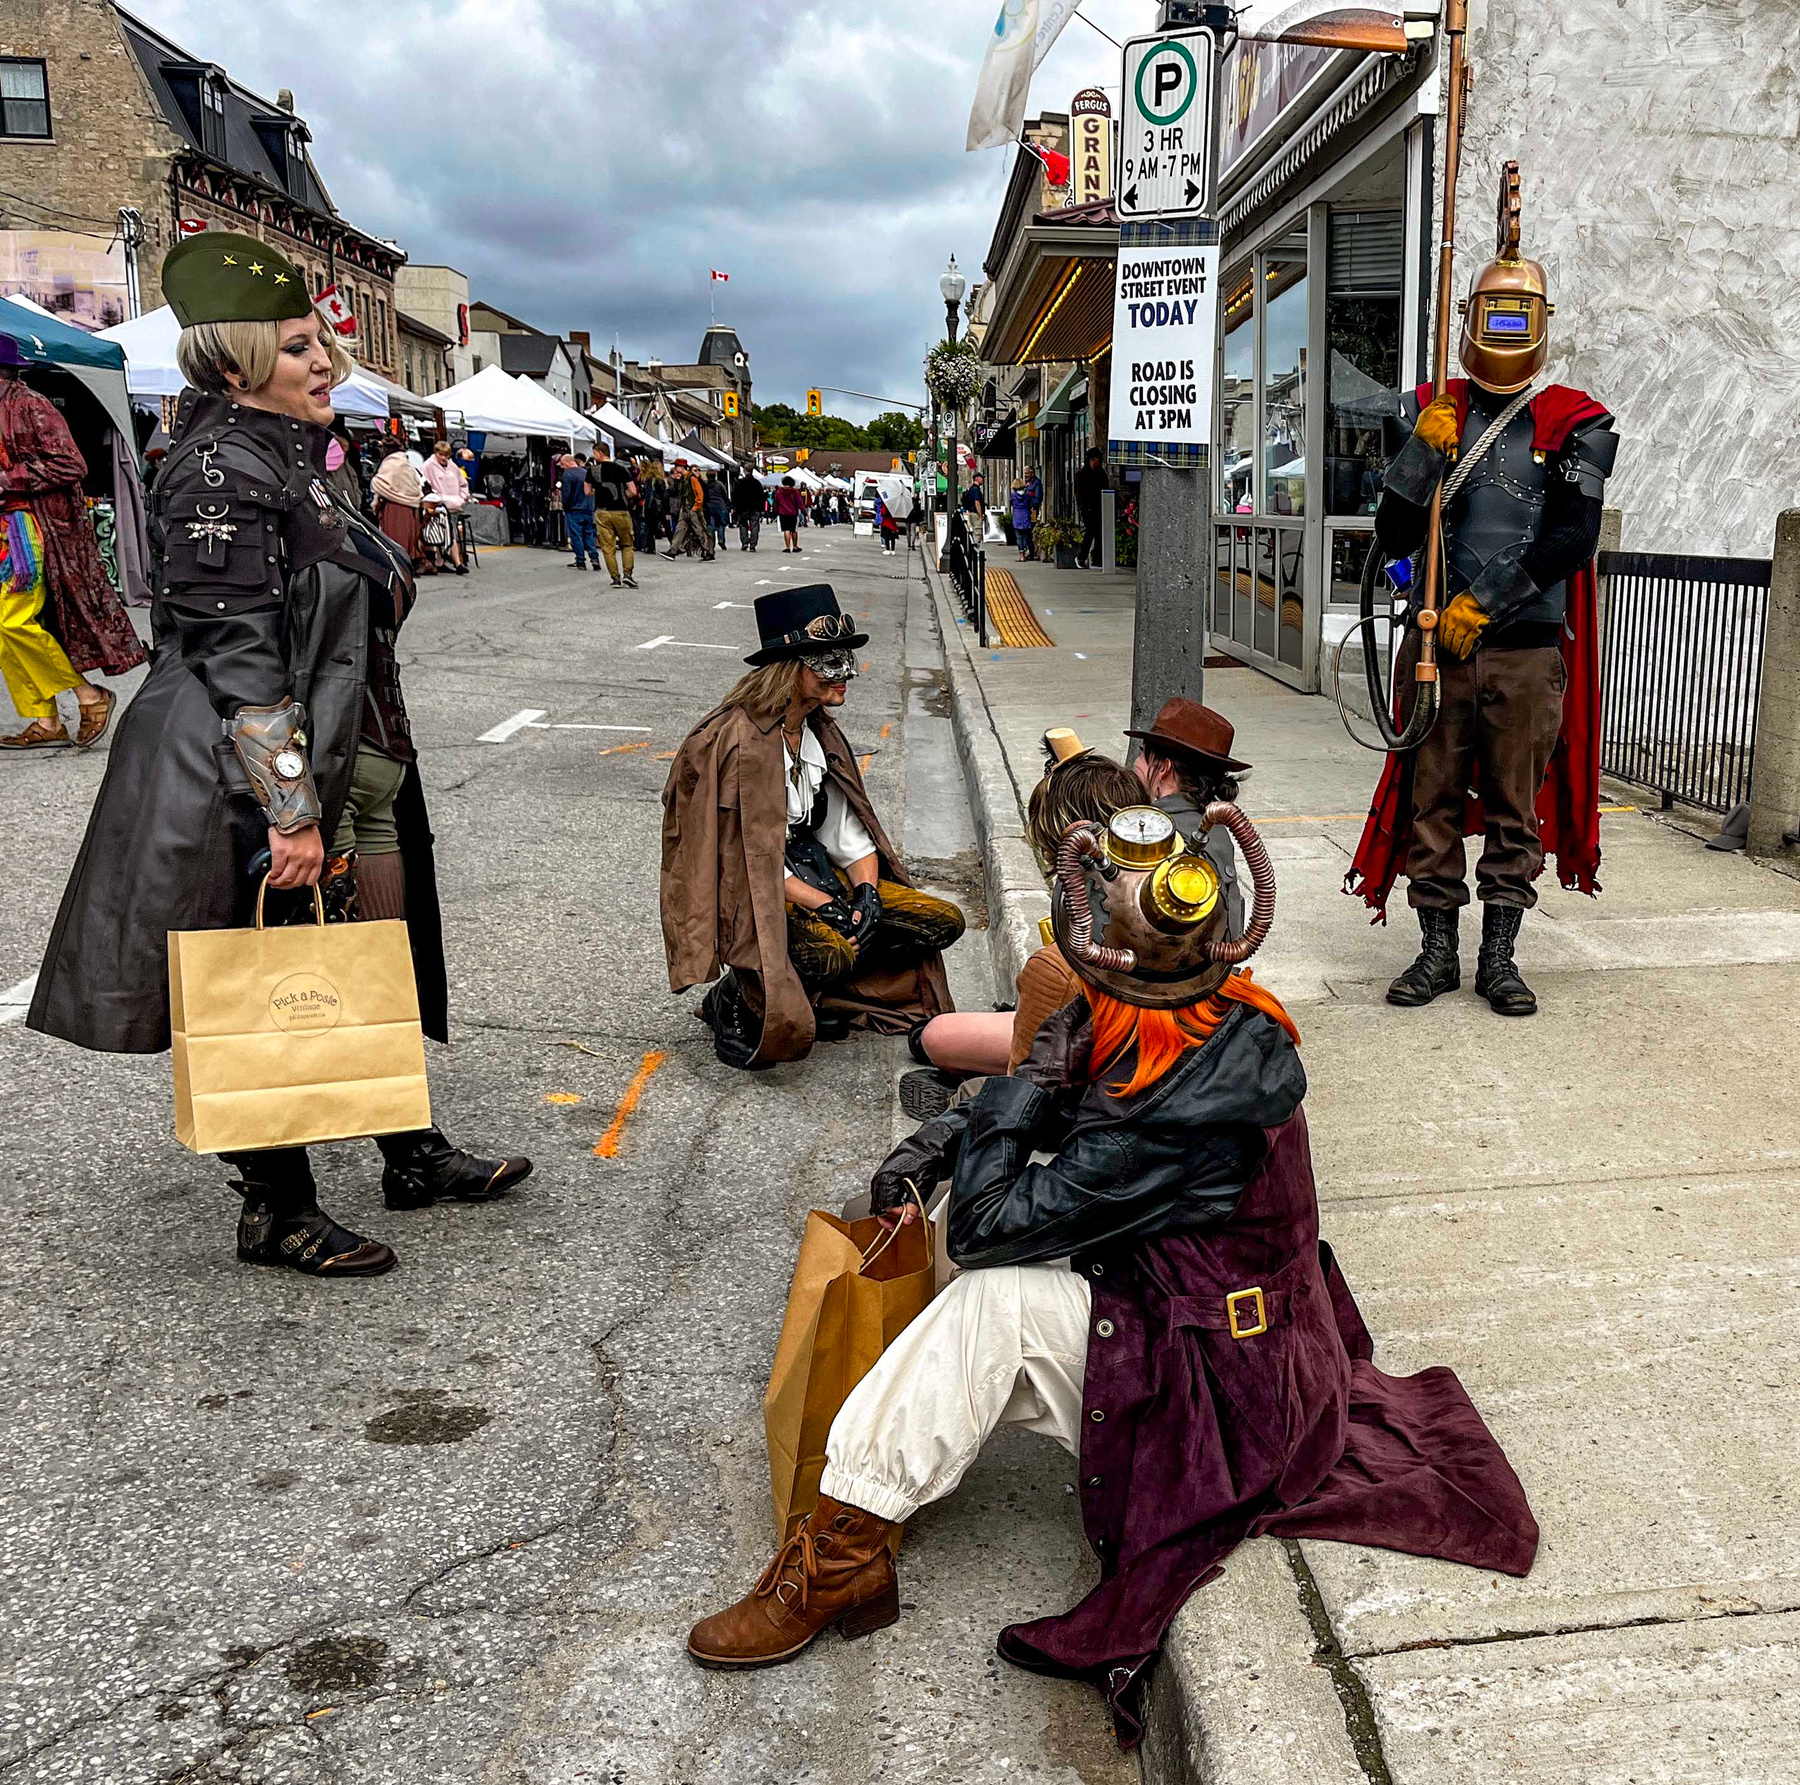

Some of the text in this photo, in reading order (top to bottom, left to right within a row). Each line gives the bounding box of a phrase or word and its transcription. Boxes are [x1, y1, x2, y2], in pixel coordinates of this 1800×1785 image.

[1154, 62, 1183, 107] P
[1074, 99, 1108, 112] FERGUS
[1143, 127, 1183, 152] 3 HR
[1083, 118, 1101, 206] GRAND
[1125, 158, 1134, 180] 9
[1138, 156, 1158, 180] AM
[1180, 152, 1200, 176] PM
[1122, 257, 1205, 280] DOWNTOWN
[1121, 277, 1206, 299] STREET EVENT
[1128, 299, 1198, 328] TODAY
[1131, 359, 1194, 382] ROAD IS
[1129, 384, 1197, 406] CLOSING
[1135, 408, 1191, 430] AT 3PM
[273, 990, 338, 1010] Pick a Posie
